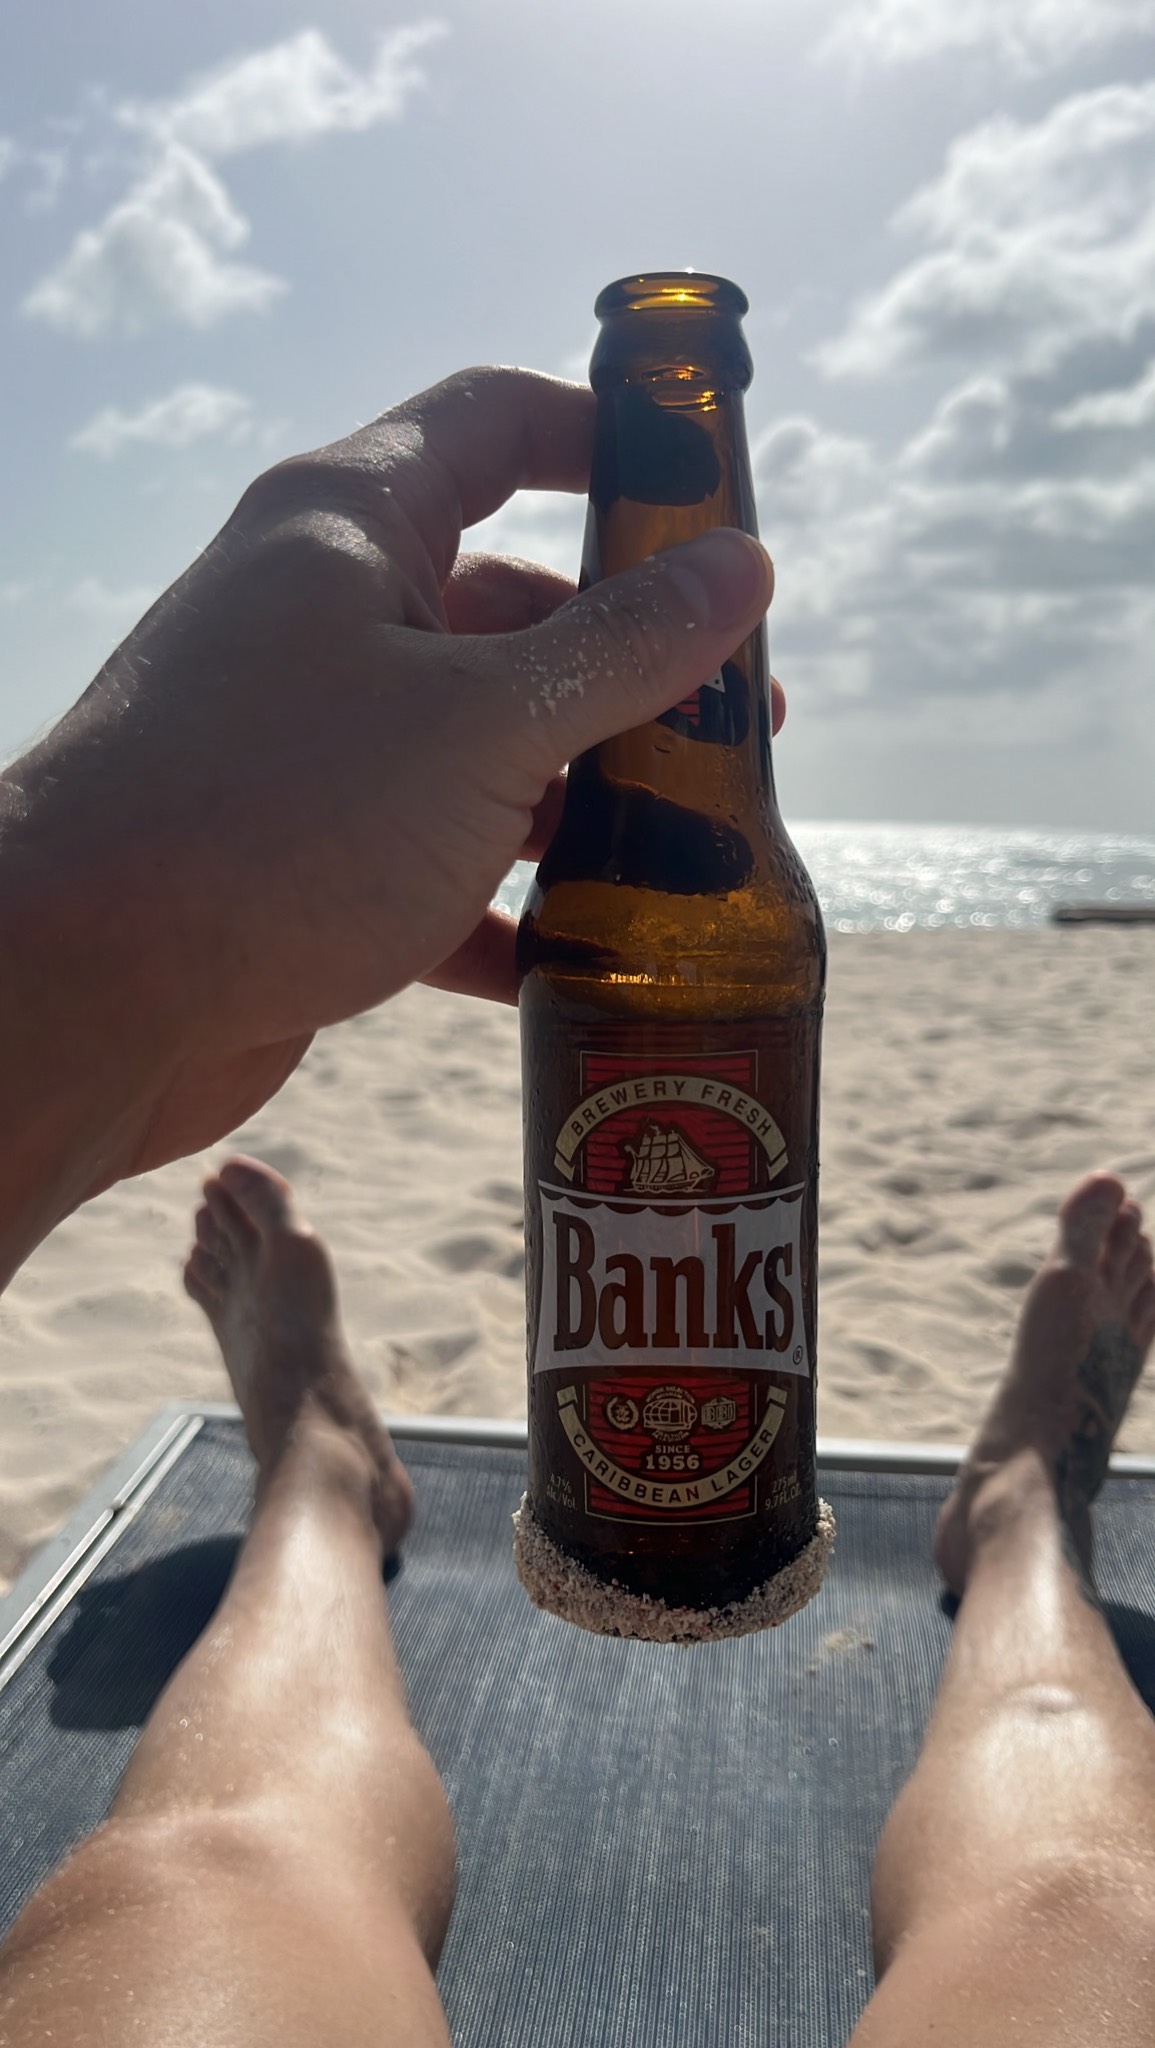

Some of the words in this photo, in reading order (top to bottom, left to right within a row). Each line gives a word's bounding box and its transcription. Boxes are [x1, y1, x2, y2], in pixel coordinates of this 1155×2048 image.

[569, 1080, 686, 1137] BREWERY
[701, 1084, 771, 1138] FRESH
[552, 1210, 794, 1353] Banks
[573, 1431, 700, 1502] CARIBBEAN
[711, 1430, 772, 1492] LAGER
[645, 1454, 700, 1471] 1956
[655, 1444, 691, 1454] SINCE
